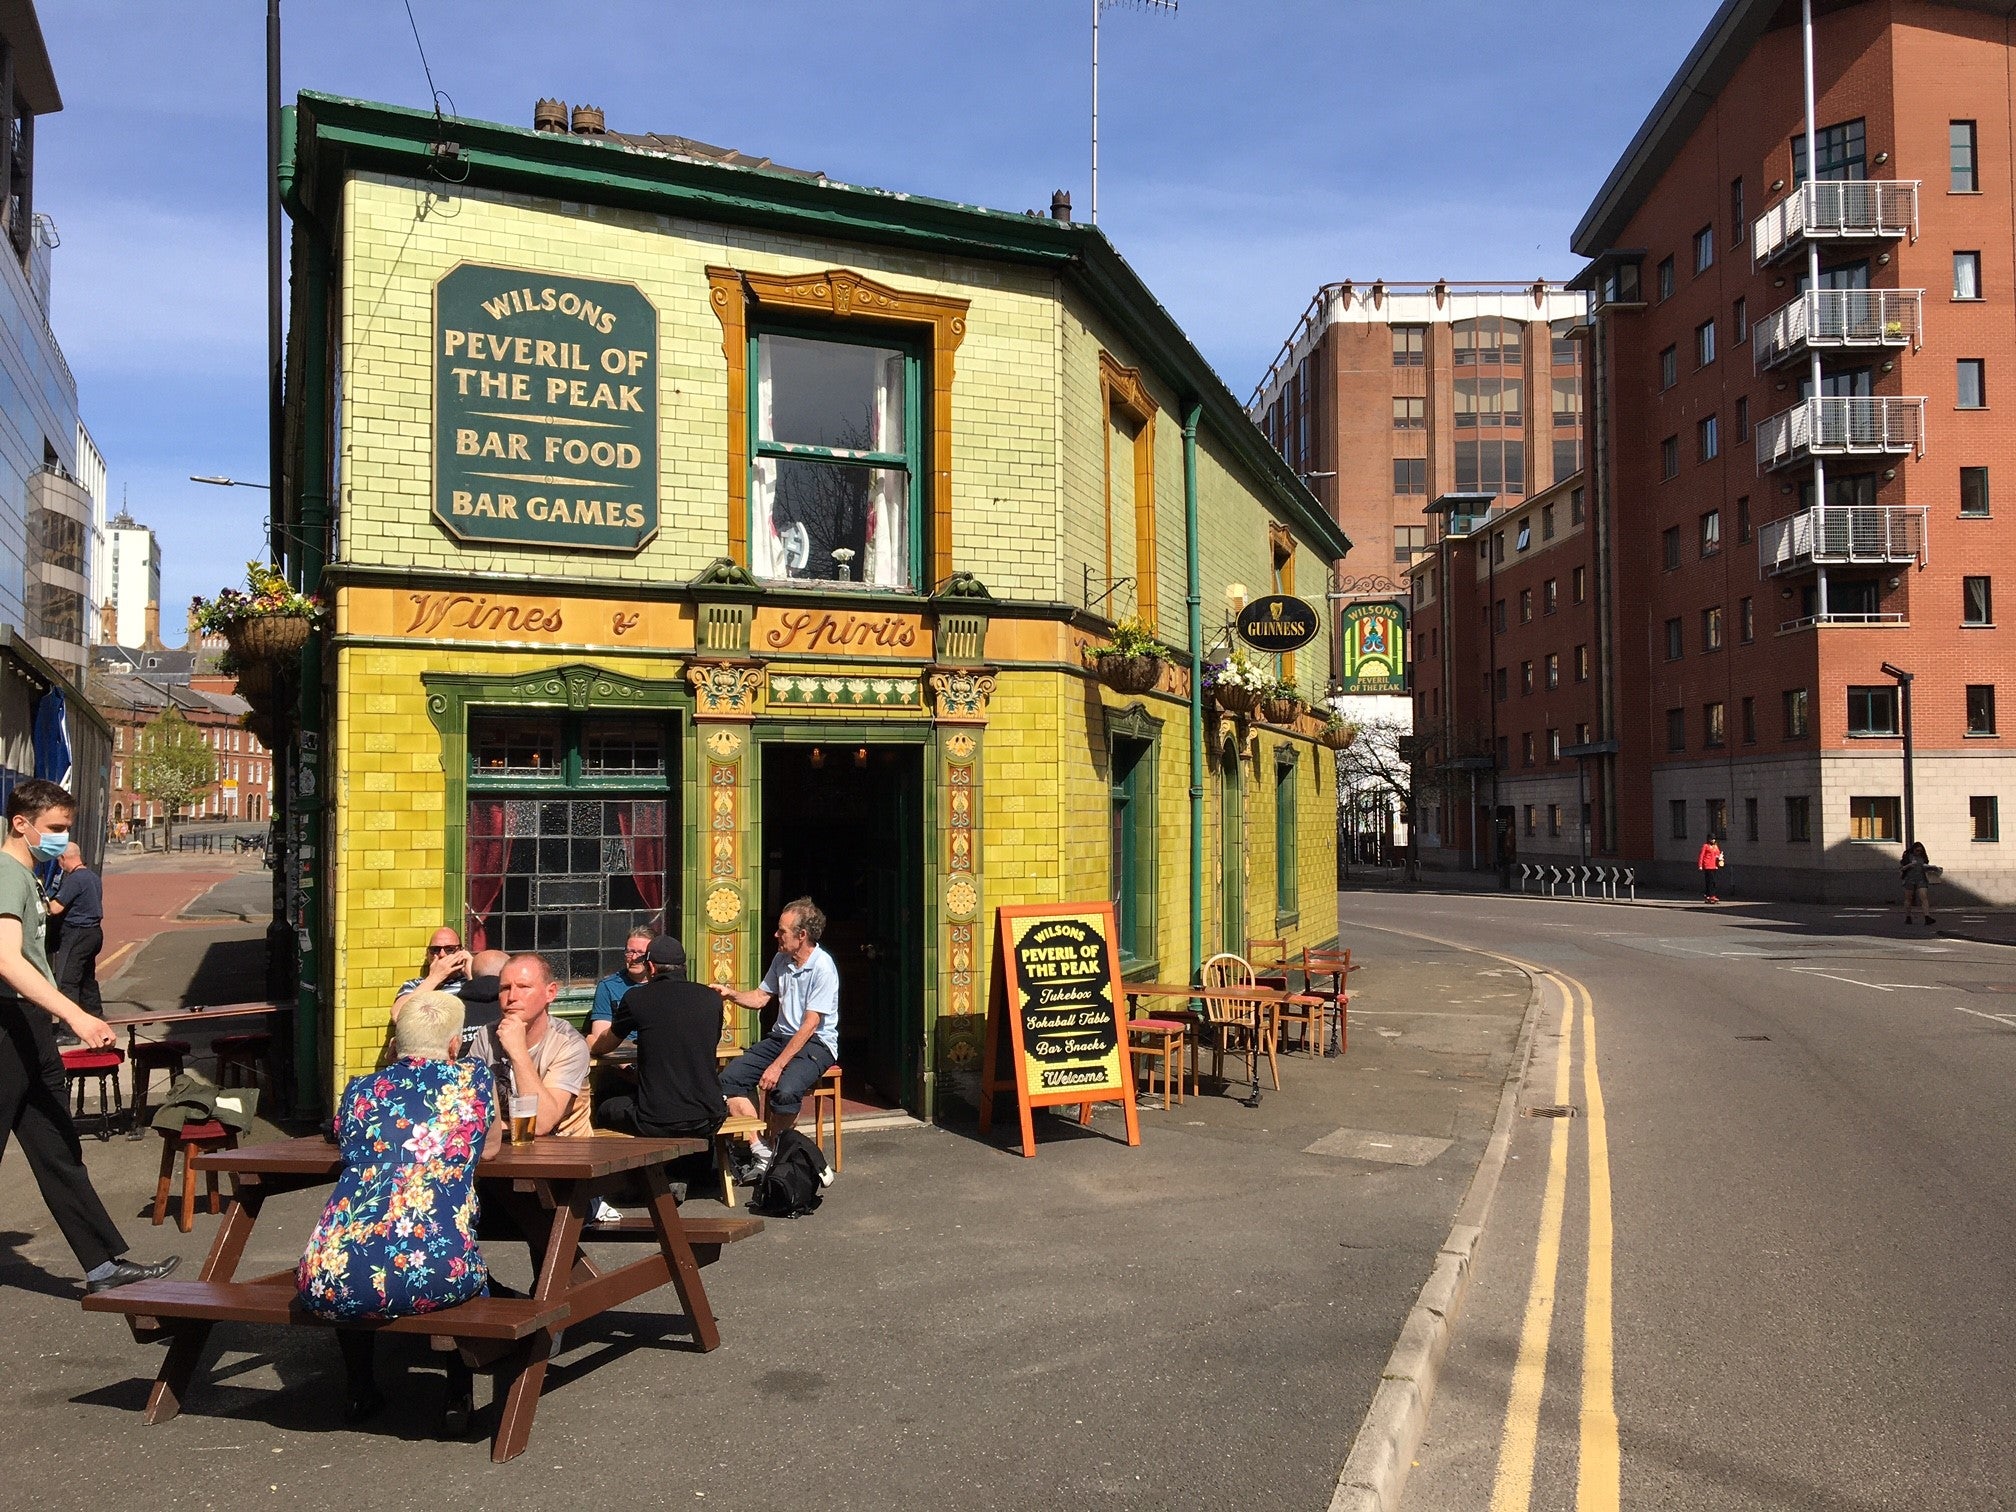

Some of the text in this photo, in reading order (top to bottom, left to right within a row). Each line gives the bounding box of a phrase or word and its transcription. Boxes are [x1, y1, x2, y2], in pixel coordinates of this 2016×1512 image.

[481, 288, 616, 334] WILSONS
[445, 330, 648, 376] PEVERIL OF
[451, 368, 644, 412] THE PEAK
[456, 428, 641, 469] BAR FOOD
[452, 490, 646, 528] BAR GAMES
[405, 594, 915, 650] Wines & Spirits
[1348, 605, 1399, 621] WILSONS
[1248, 621, 1305, 636] GUINNESS
[1350, 683, 1400, 692] OF THE PEAK
[1357, 676, 1390, 684] PEVERIL
[1033, 924, 1086, 944] WILSONS
[1021, 944, 1100, 962] PEVERIL OF
[1025, 960, 1101, 978] THE PEAK
[1039, 987, 1092, 1004] Jukebox
[1078, 1011, 1111, 1026] Table
[1035, 1038, 1107, 1056] Bar Snacks
[1043, 1070, 1105, 1086] Welcome
